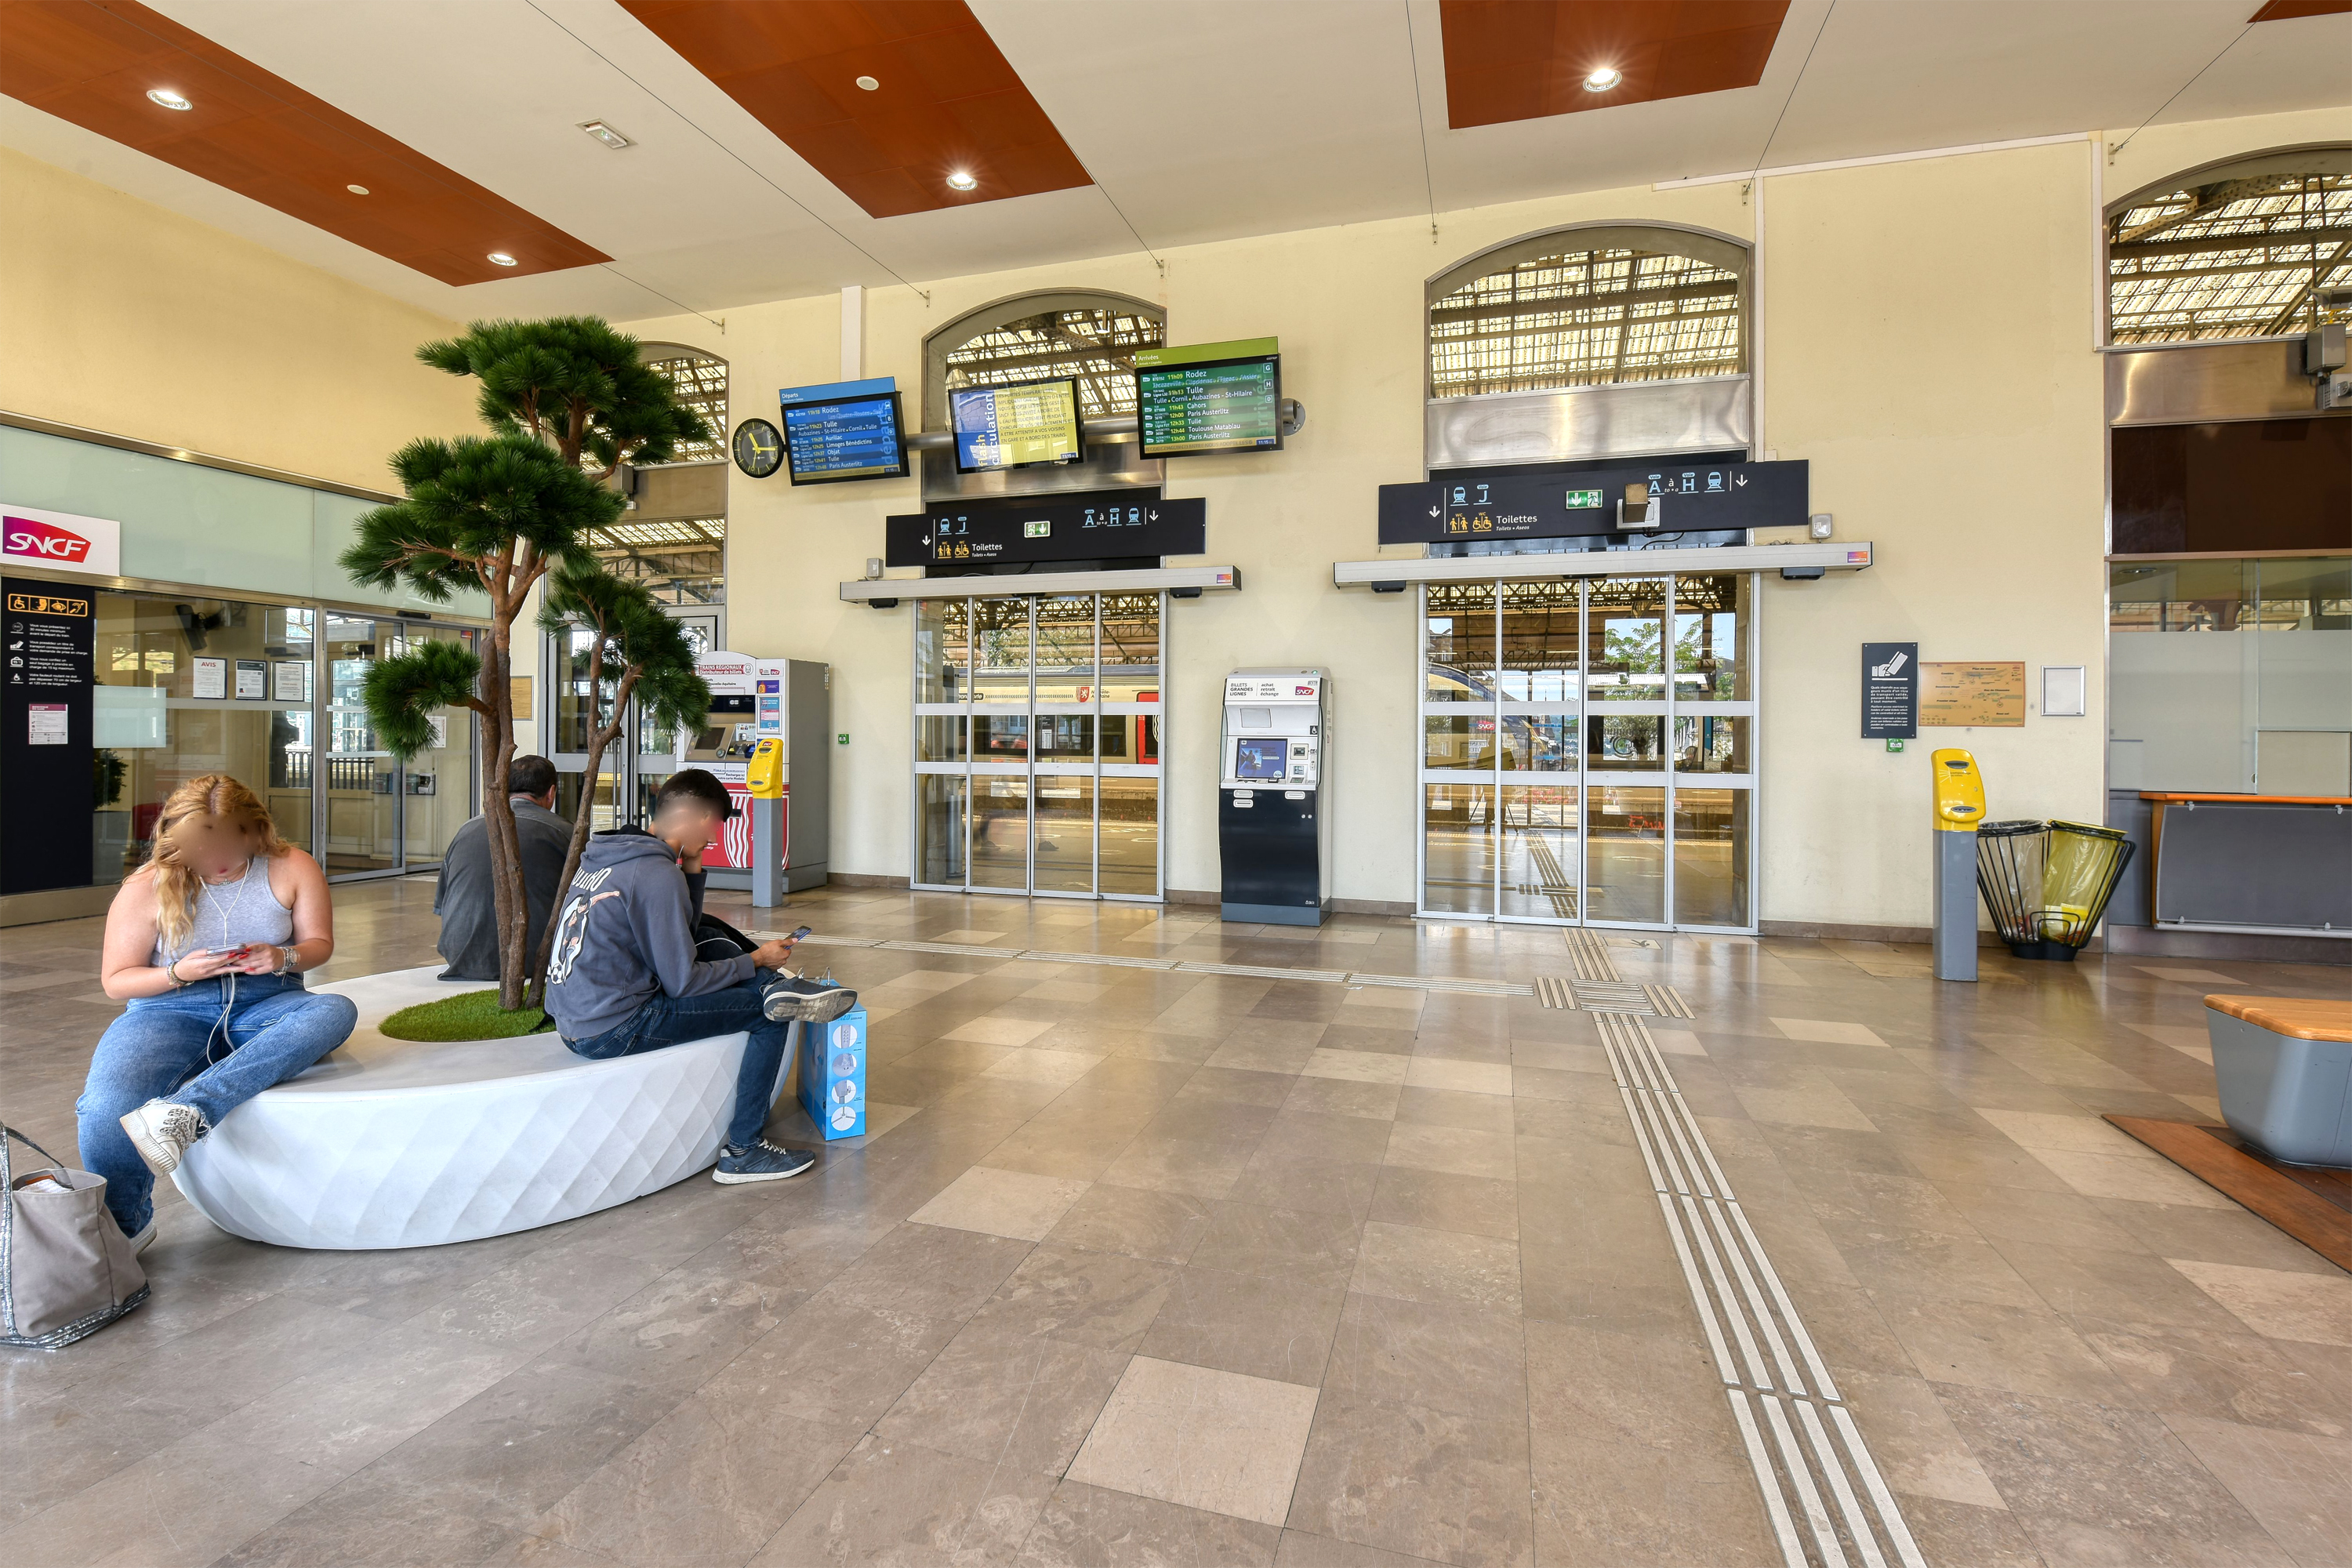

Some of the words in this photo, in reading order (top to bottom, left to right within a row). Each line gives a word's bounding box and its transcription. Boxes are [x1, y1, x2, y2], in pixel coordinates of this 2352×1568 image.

[985, 394, 1001, 466] circulation
[976, 435, 987, 467] flash
[1649, 480, 1661, 493] A
[1668, 478, 1674, 487] à
[1683, 479, 1694, 491] H
[1479, 490, 1487, 502] J
[1085, 515, 1094, 526] A
[1110, 513, 1119, 524] H
[1496, 515, 1537, 524] Toilettes
[959, 522, 965, 532] J
[6, 532, 86, 556] SNCF
